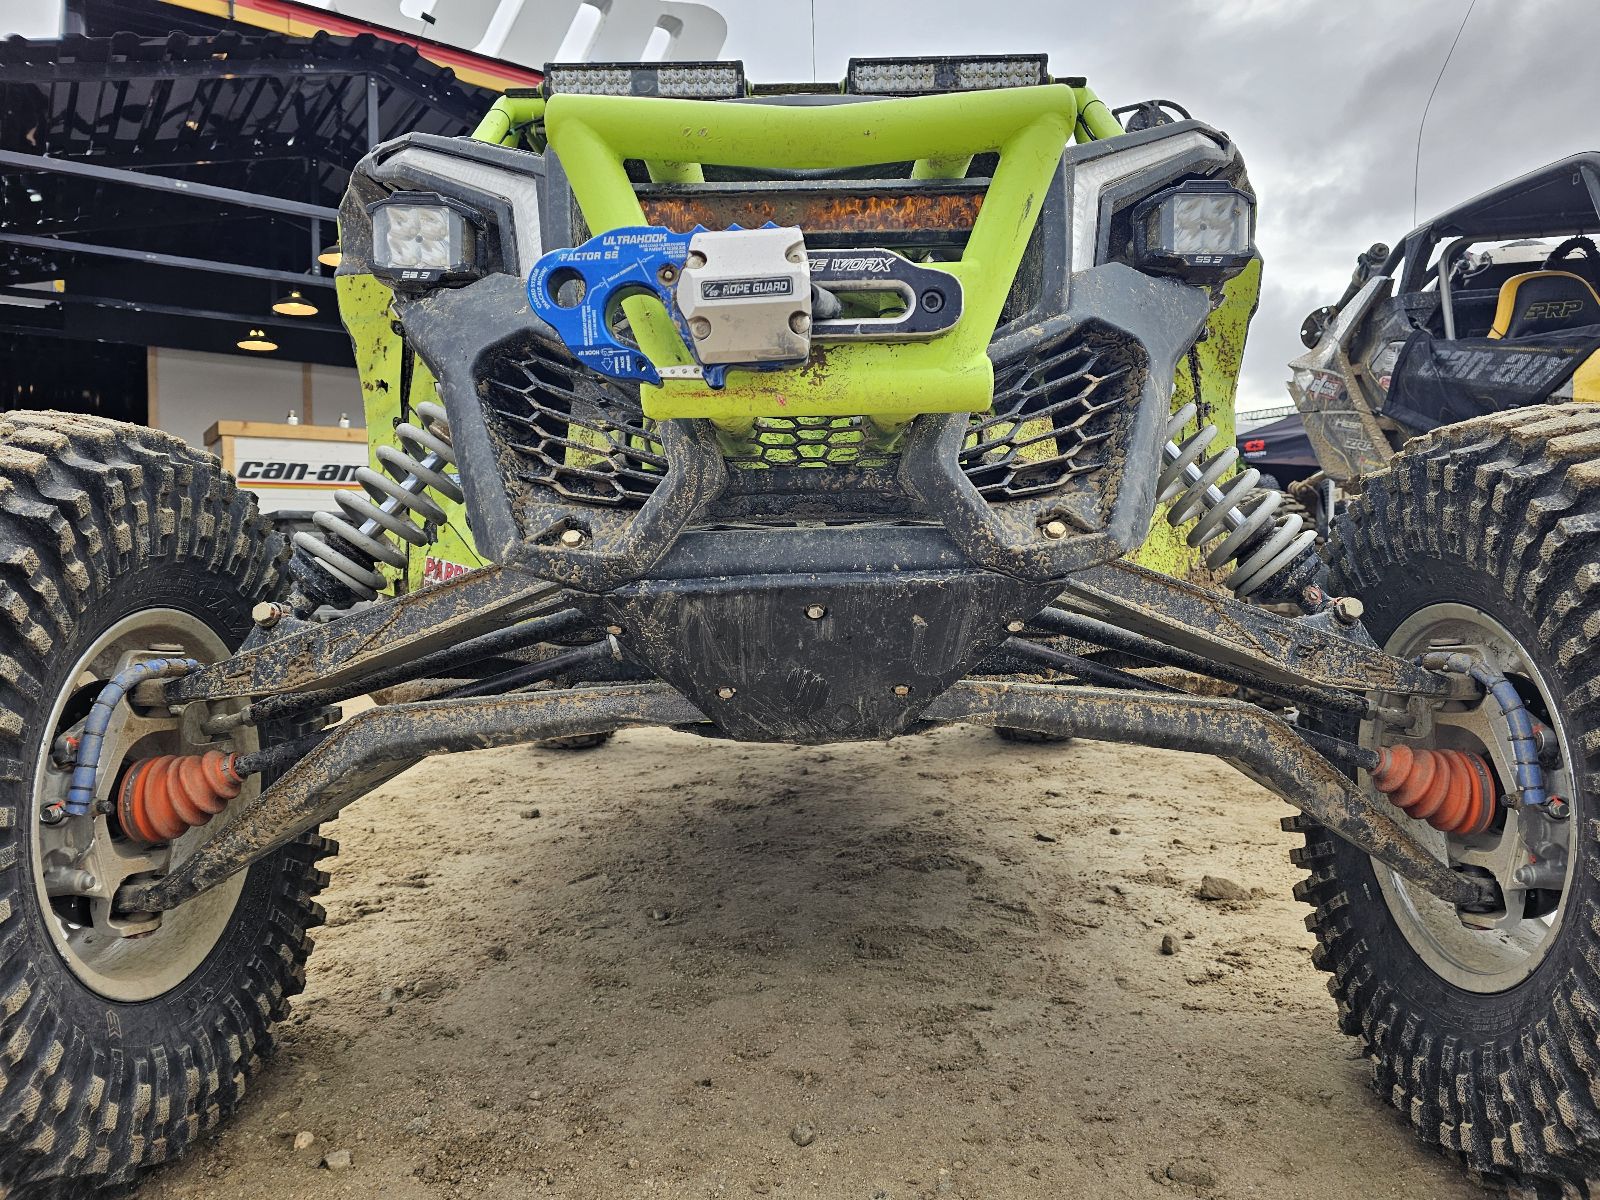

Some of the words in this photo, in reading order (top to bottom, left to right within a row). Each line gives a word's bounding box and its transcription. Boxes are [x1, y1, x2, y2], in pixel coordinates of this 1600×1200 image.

[603, 233, 667, 246] ULTRAHOOK
[560, 252, 601, 261] FACTOR
[1195, 256, 1211, 264] SS
[1213, 256, 1223, 264] 3
[831, 257, 896, 272] WORX
[420, 271, 431, 279] 3
[722, 283, 750, 295] ROPE
[752, 281, 788, 293] GUARD
[1524, 300, 1583, 320] PRP
